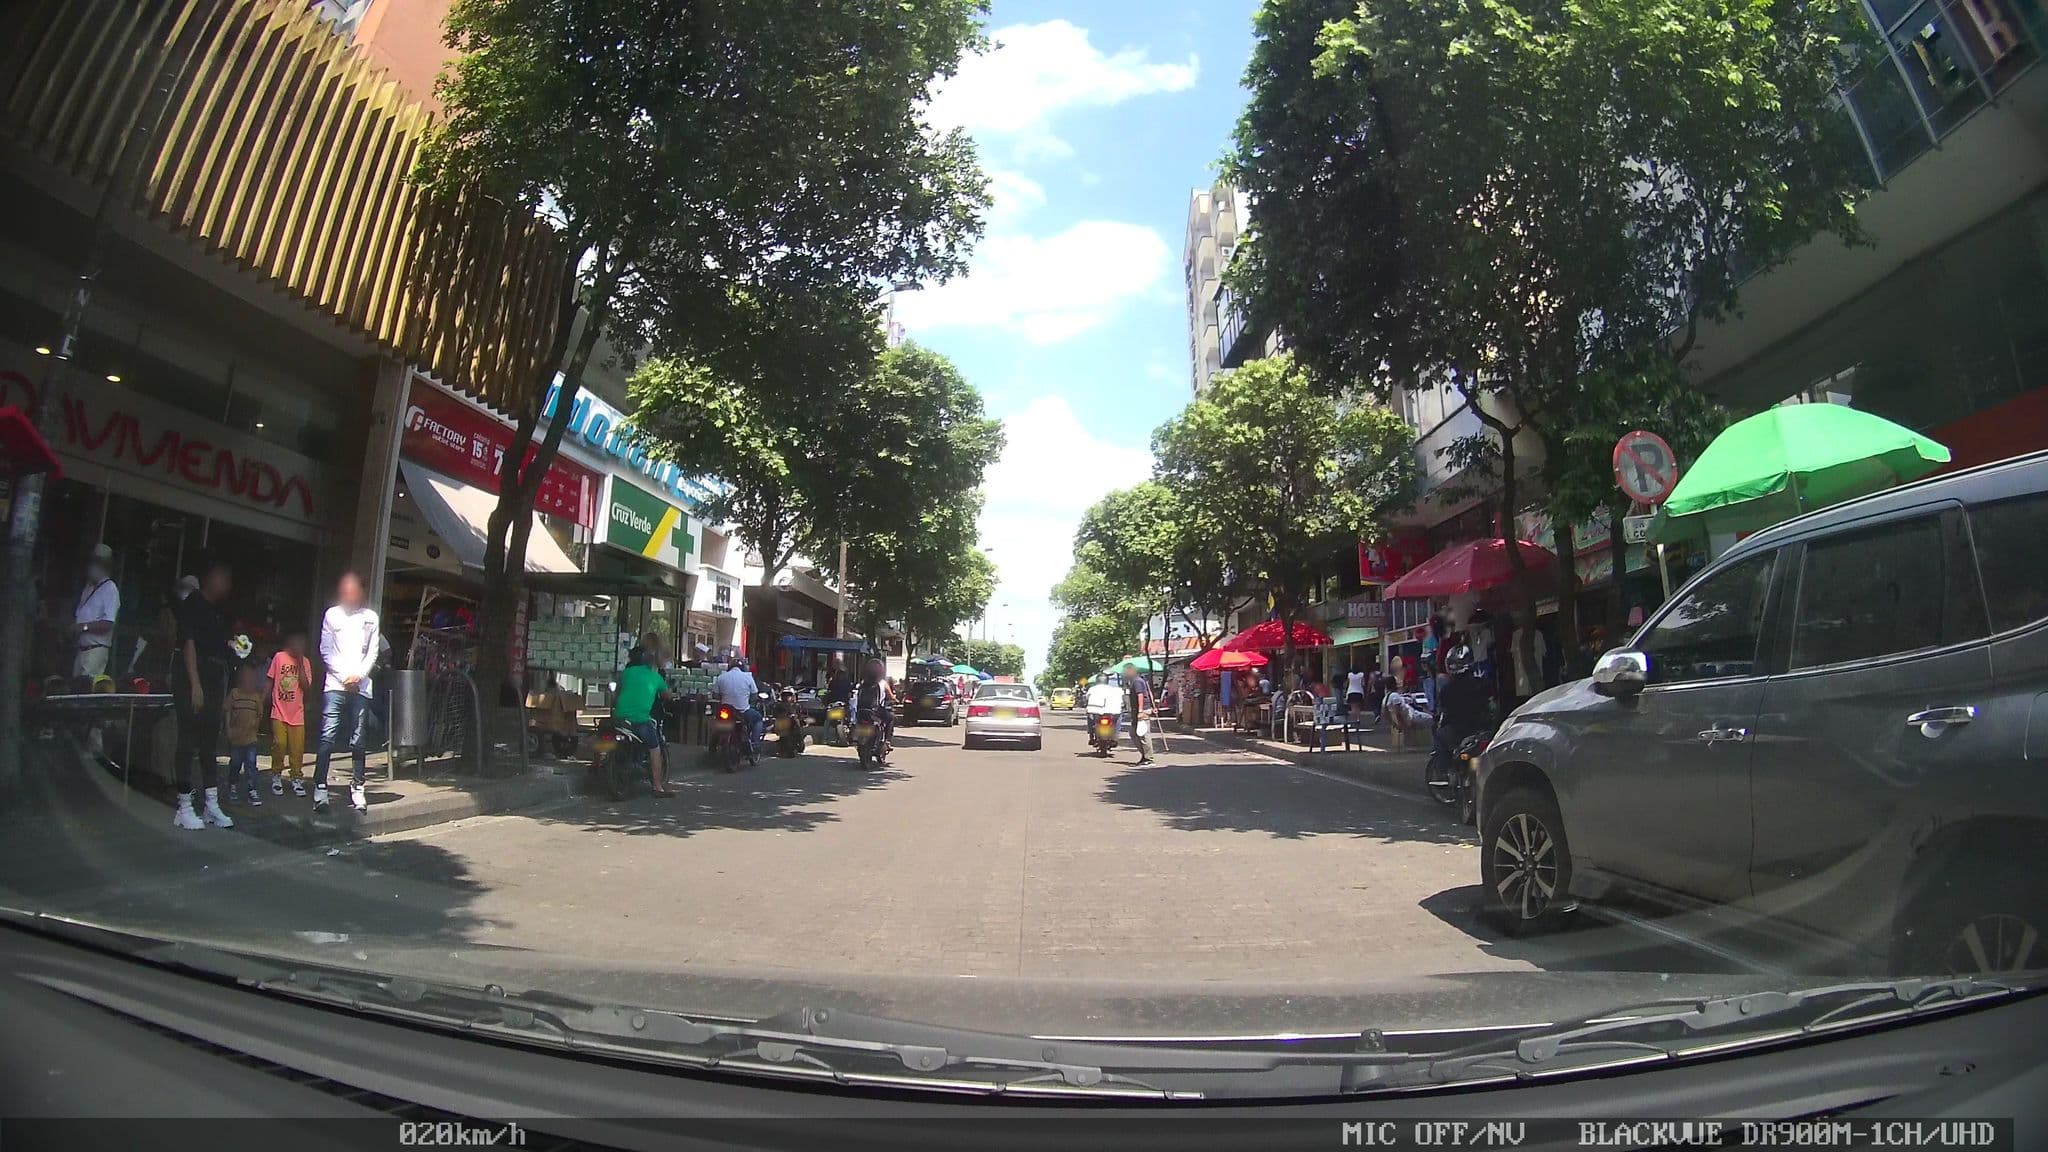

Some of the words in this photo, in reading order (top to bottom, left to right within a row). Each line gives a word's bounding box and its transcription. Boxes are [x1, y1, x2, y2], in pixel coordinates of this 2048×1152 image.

[423, 418, 467, 445] FACTORY
[611, 501, 631, 526] Cruz
[630, 510, 652, 535] Verde
[1347, 602, 1386, 618] HOTEL
